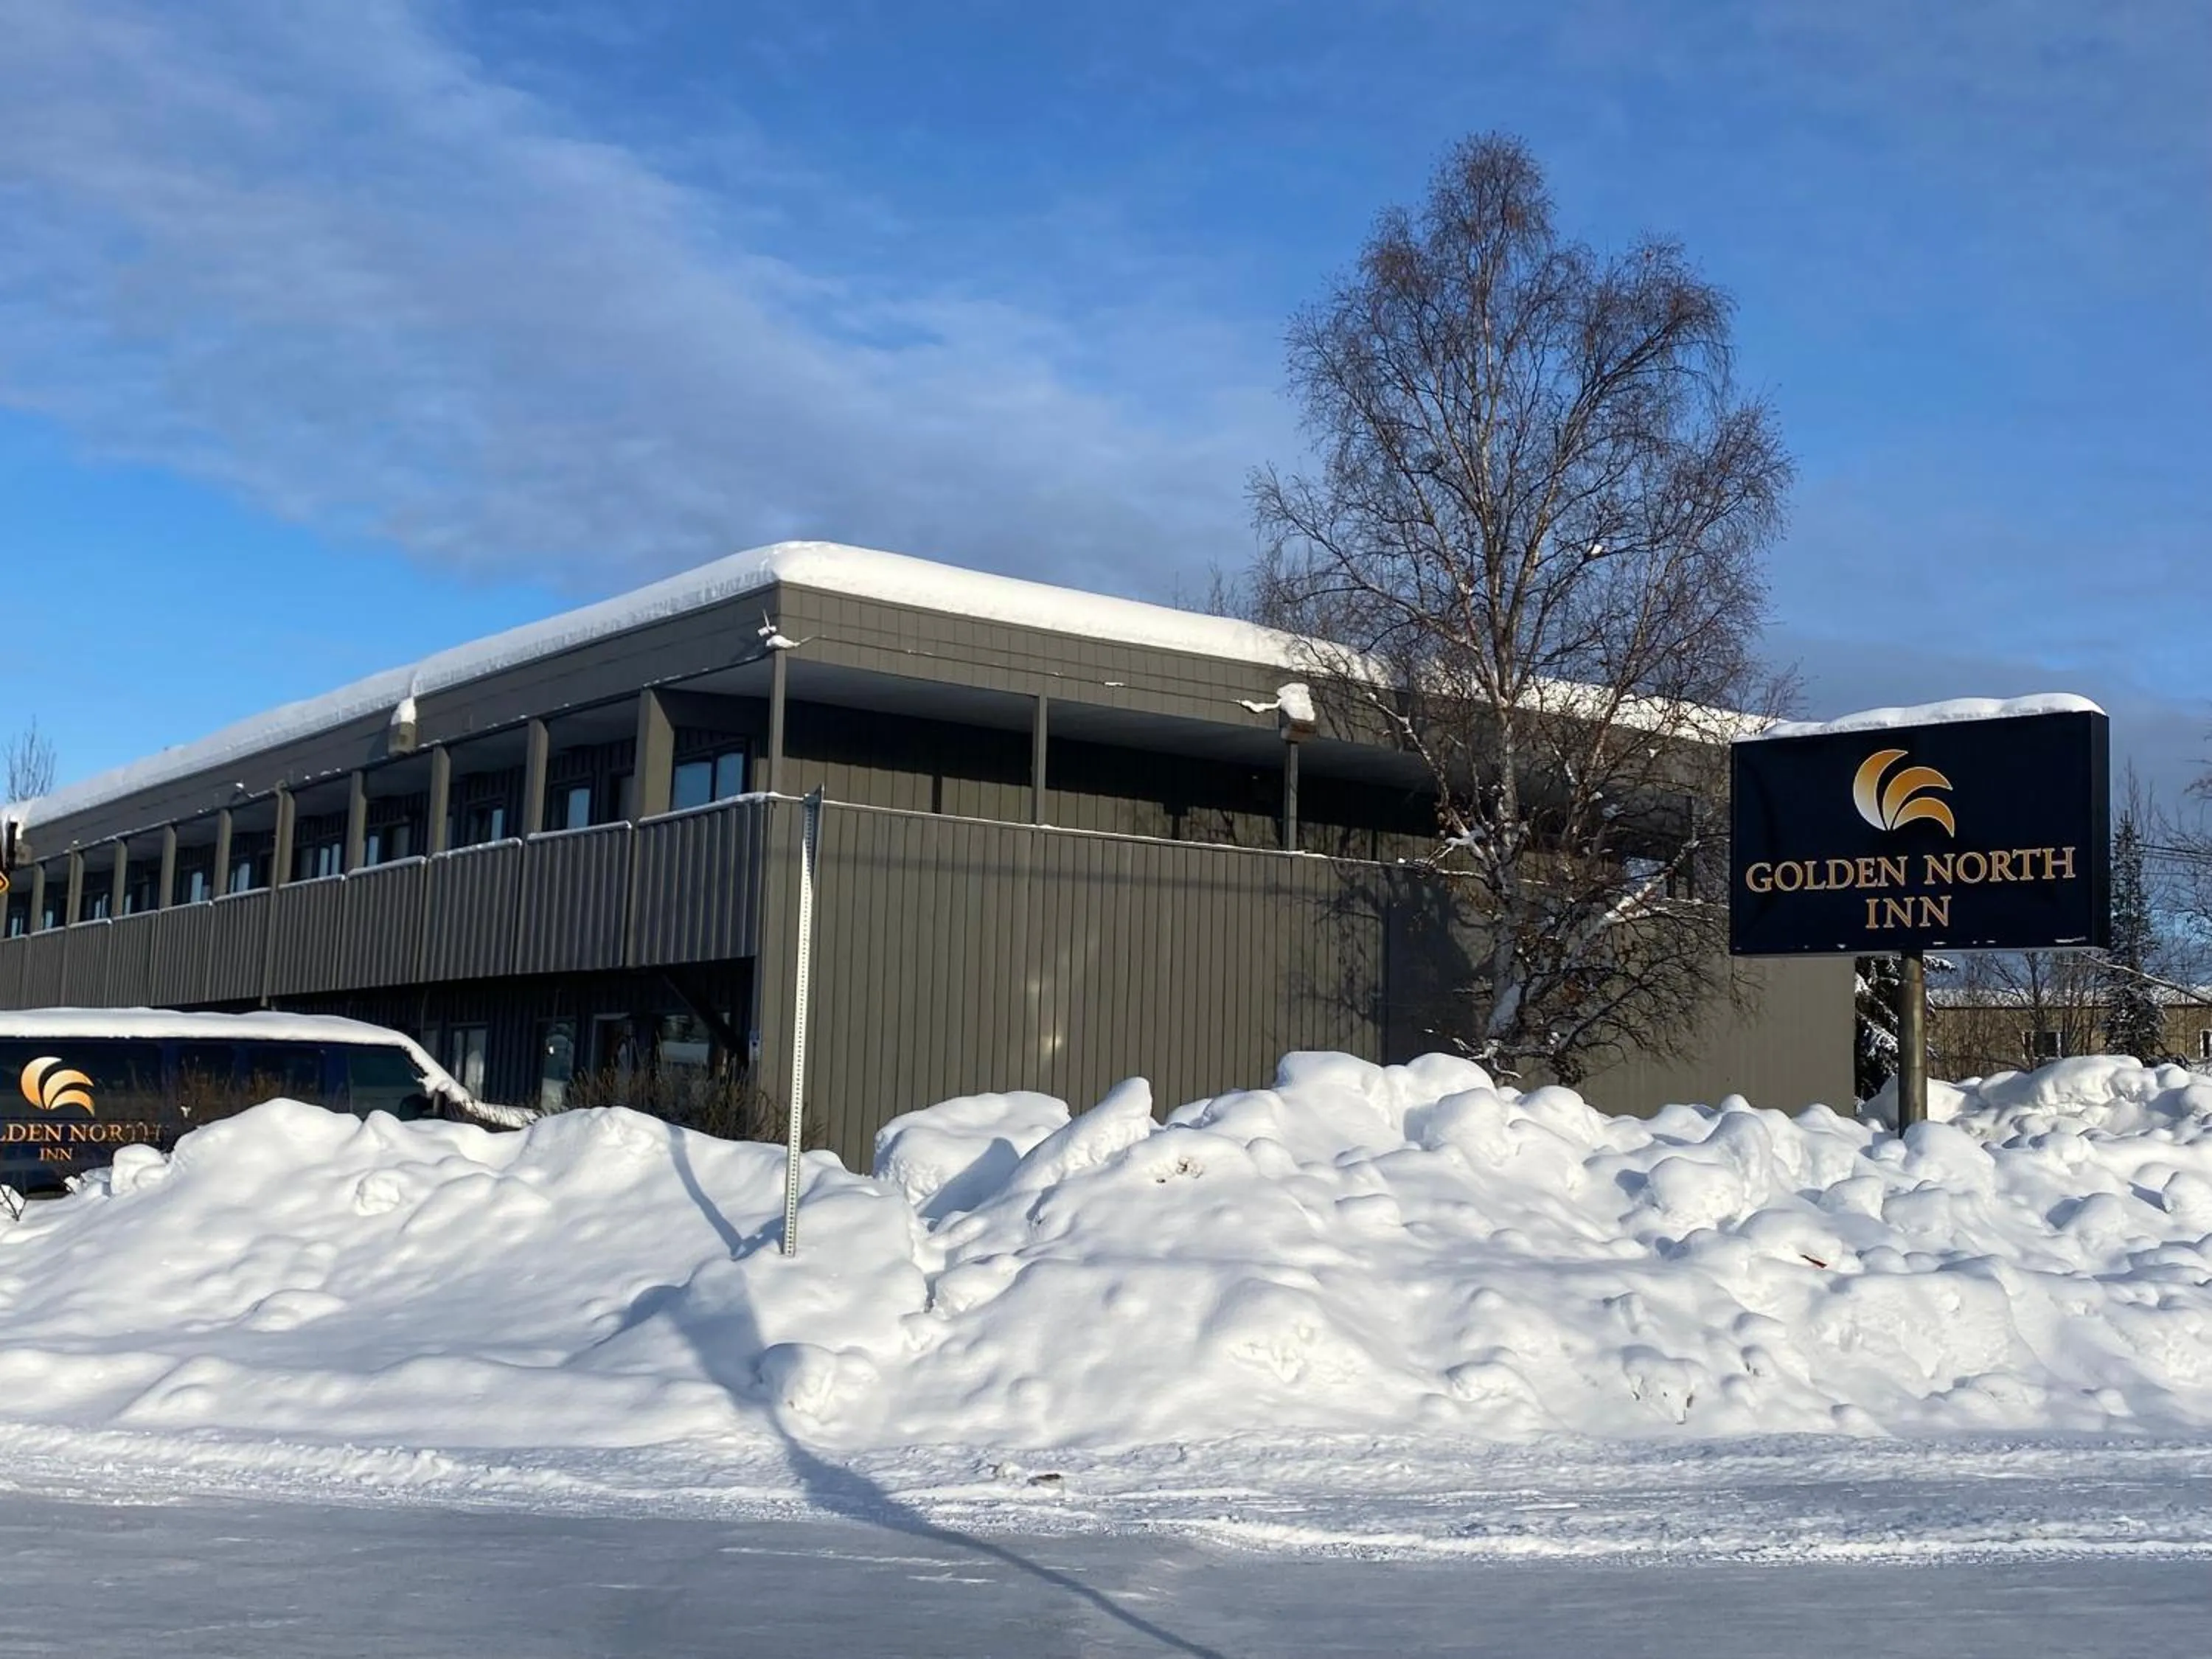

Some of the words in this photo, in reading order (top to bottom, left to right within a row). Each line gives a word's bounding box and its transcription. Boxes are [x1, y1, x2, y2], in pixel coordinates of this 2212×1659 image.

[1745, 855, 1908, 893] GOLDEN
[1923, 846, 2076, 884] NORTH
[1865, 896, 1952, 929] INN
[69, 1122, 161, 1142] NORTH
[39, 1147, 73, 1161] INN
